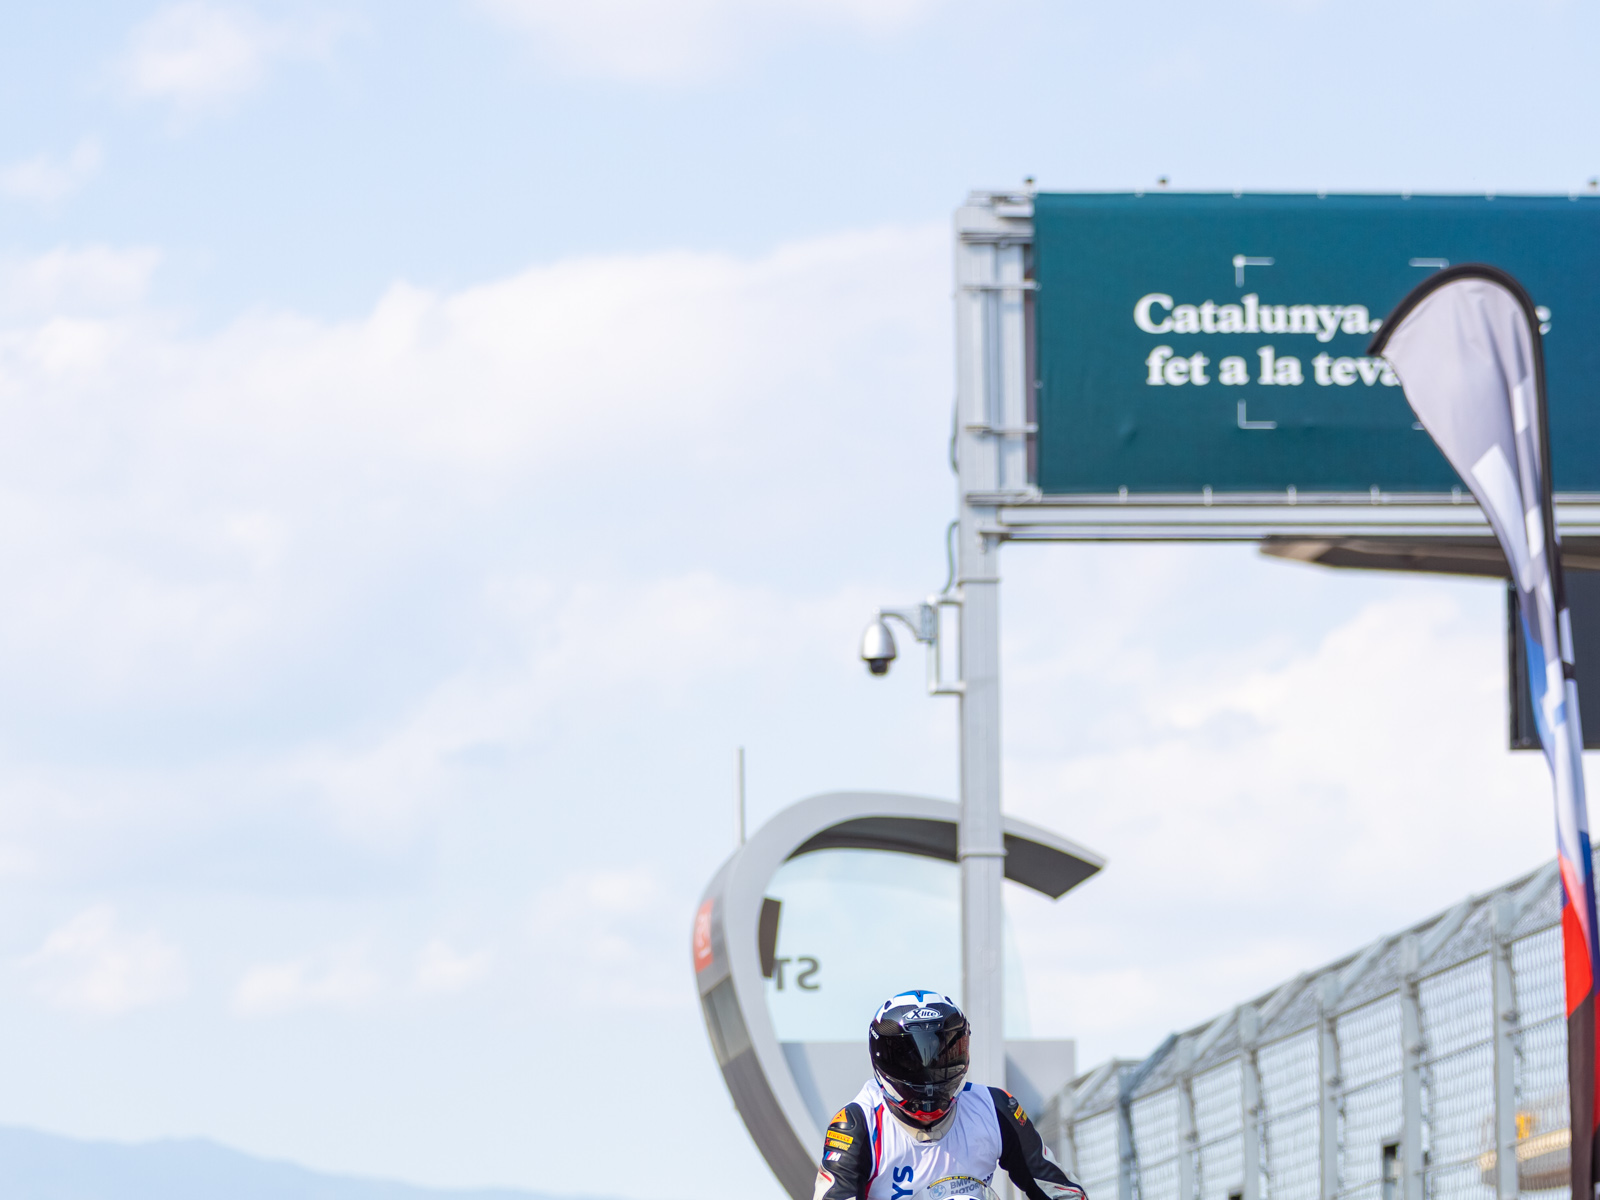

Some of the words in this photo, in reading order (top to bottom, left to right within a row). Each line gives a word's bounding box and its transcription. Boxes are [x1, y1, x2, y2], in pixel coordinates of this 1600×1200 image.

[1145, 345, 1210, 386] fet
[1218, 356, 1249, 386] a
[1257, 345, 1304, 386] la
[911, 1009, 936, 1019] X-lite
